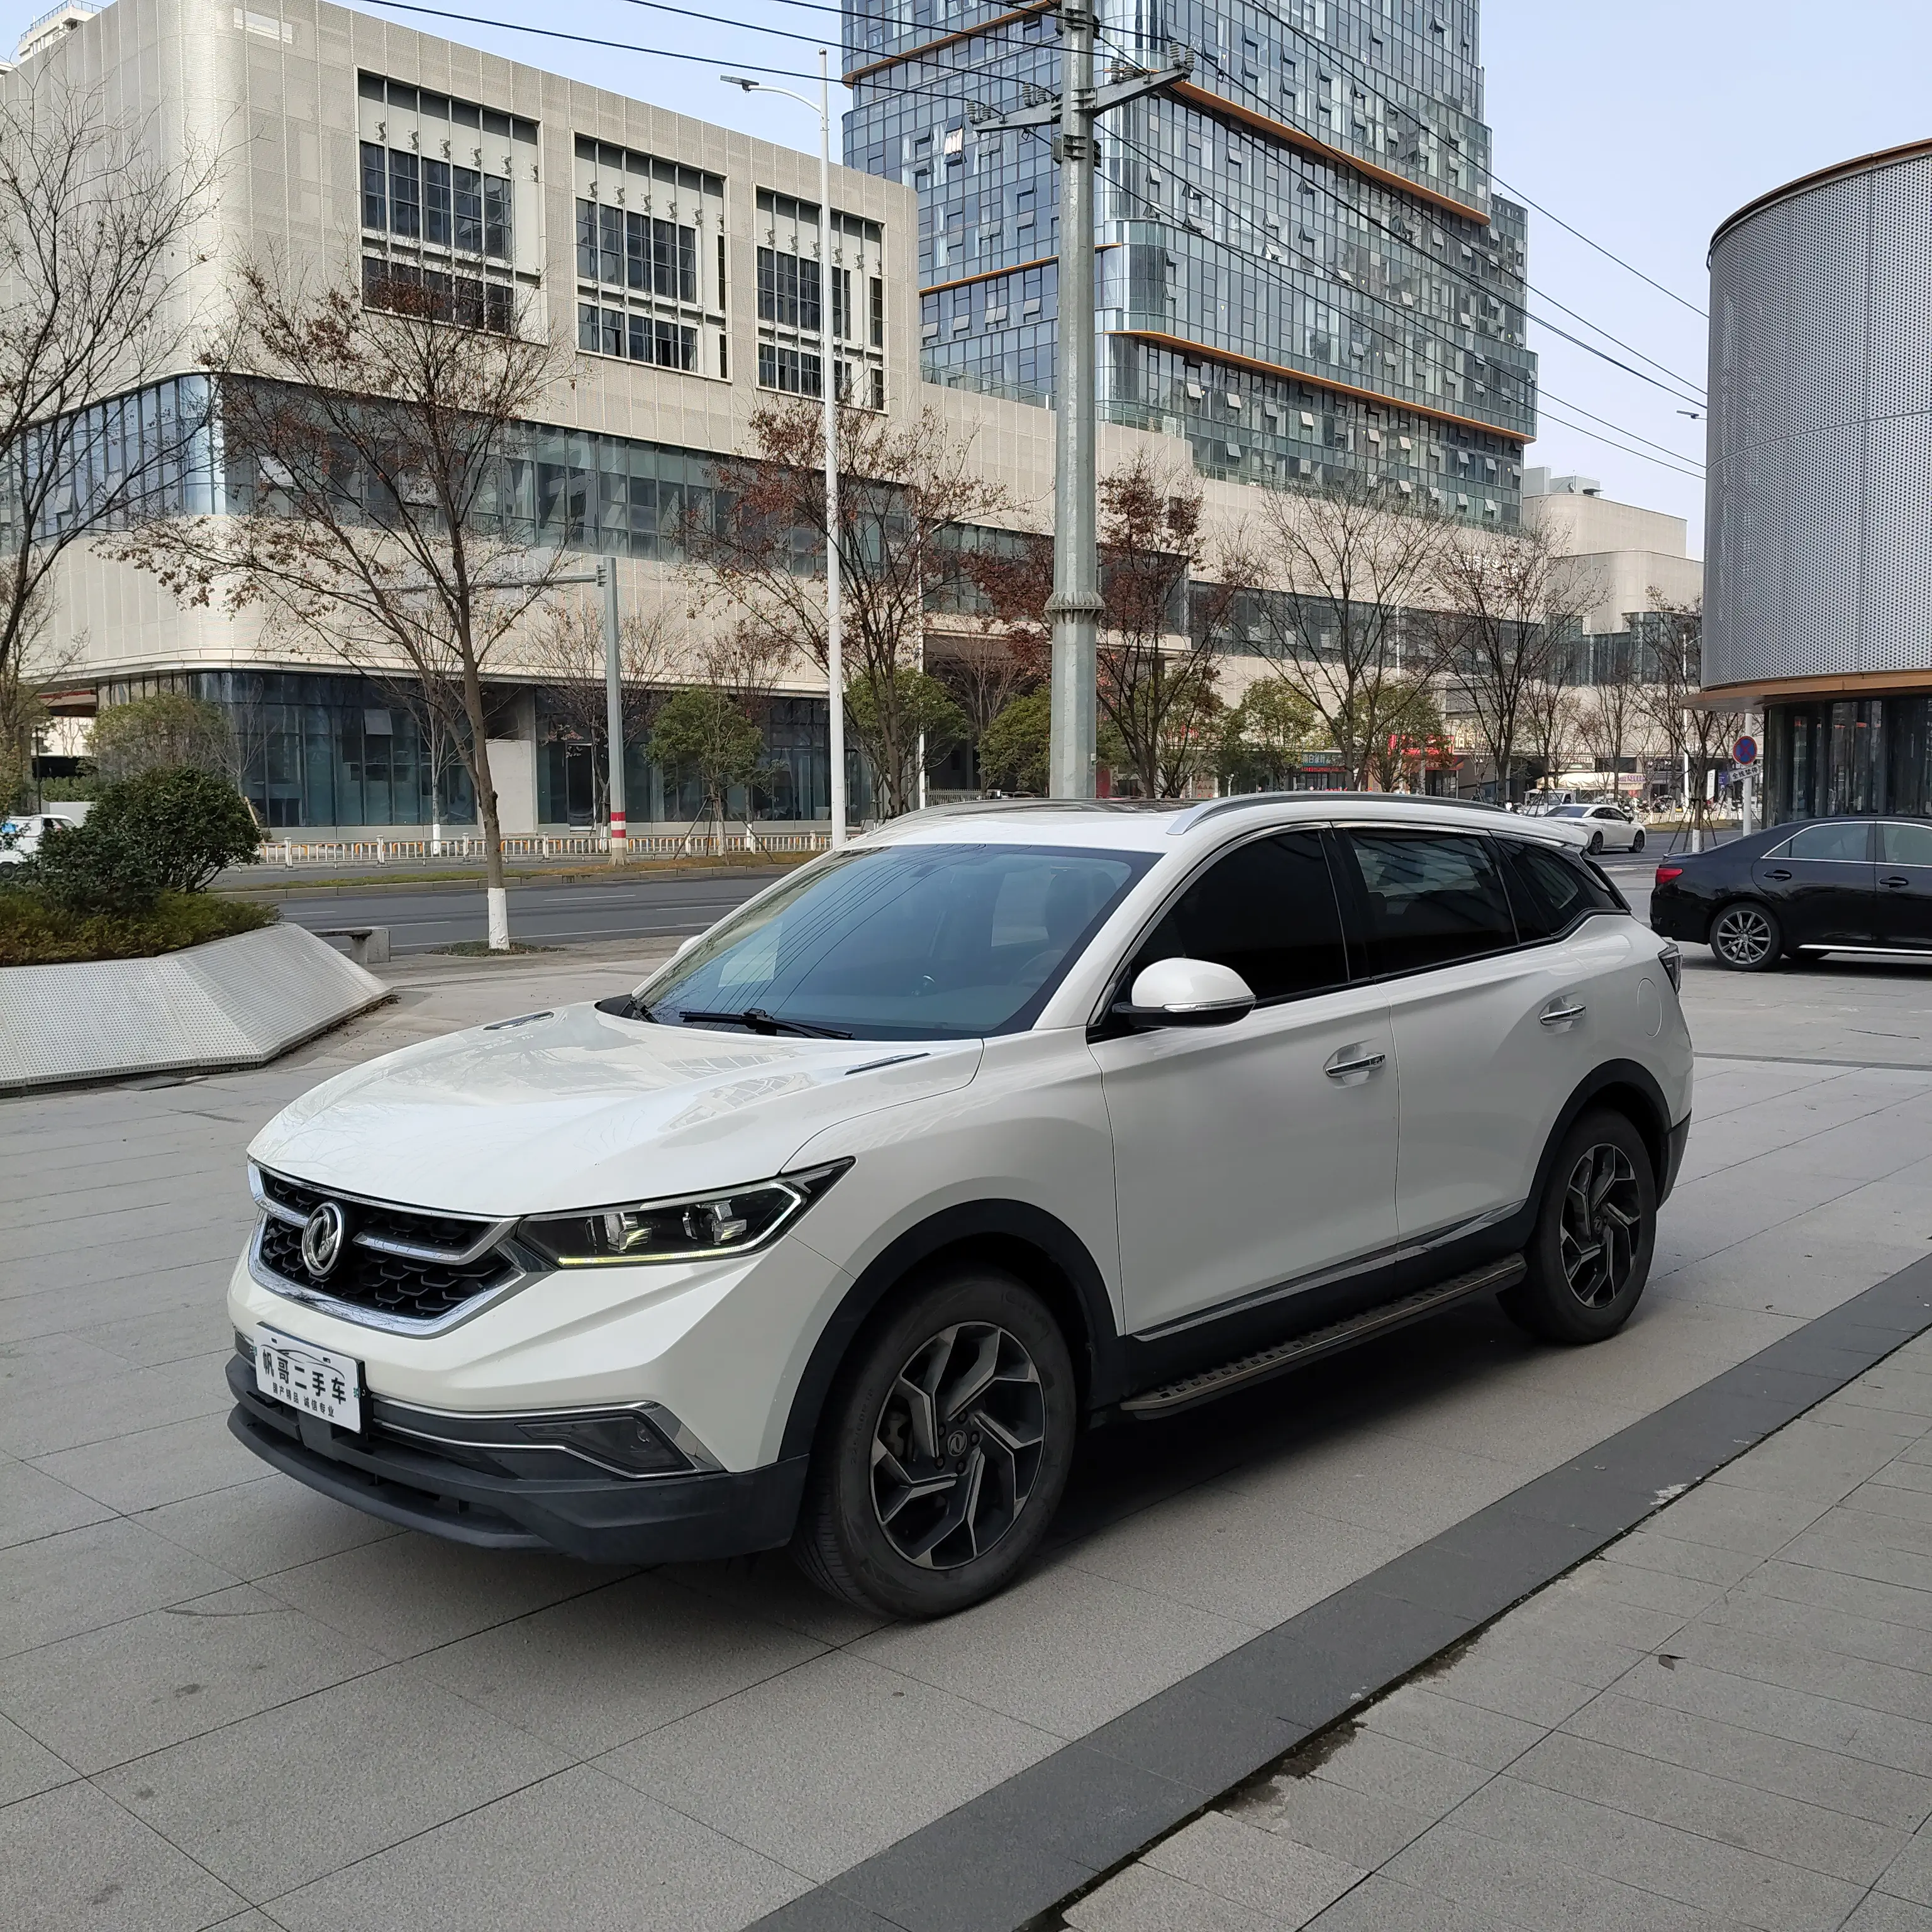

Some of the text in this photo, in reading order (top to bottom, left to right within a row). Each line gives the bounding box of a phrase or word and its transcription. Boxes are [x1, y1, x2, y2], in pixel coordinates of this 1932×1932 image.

[262, 1348, 347, 1405] 帆哥二手车
[272, 1382, 335, 1418] 国产精品 诚信专业
